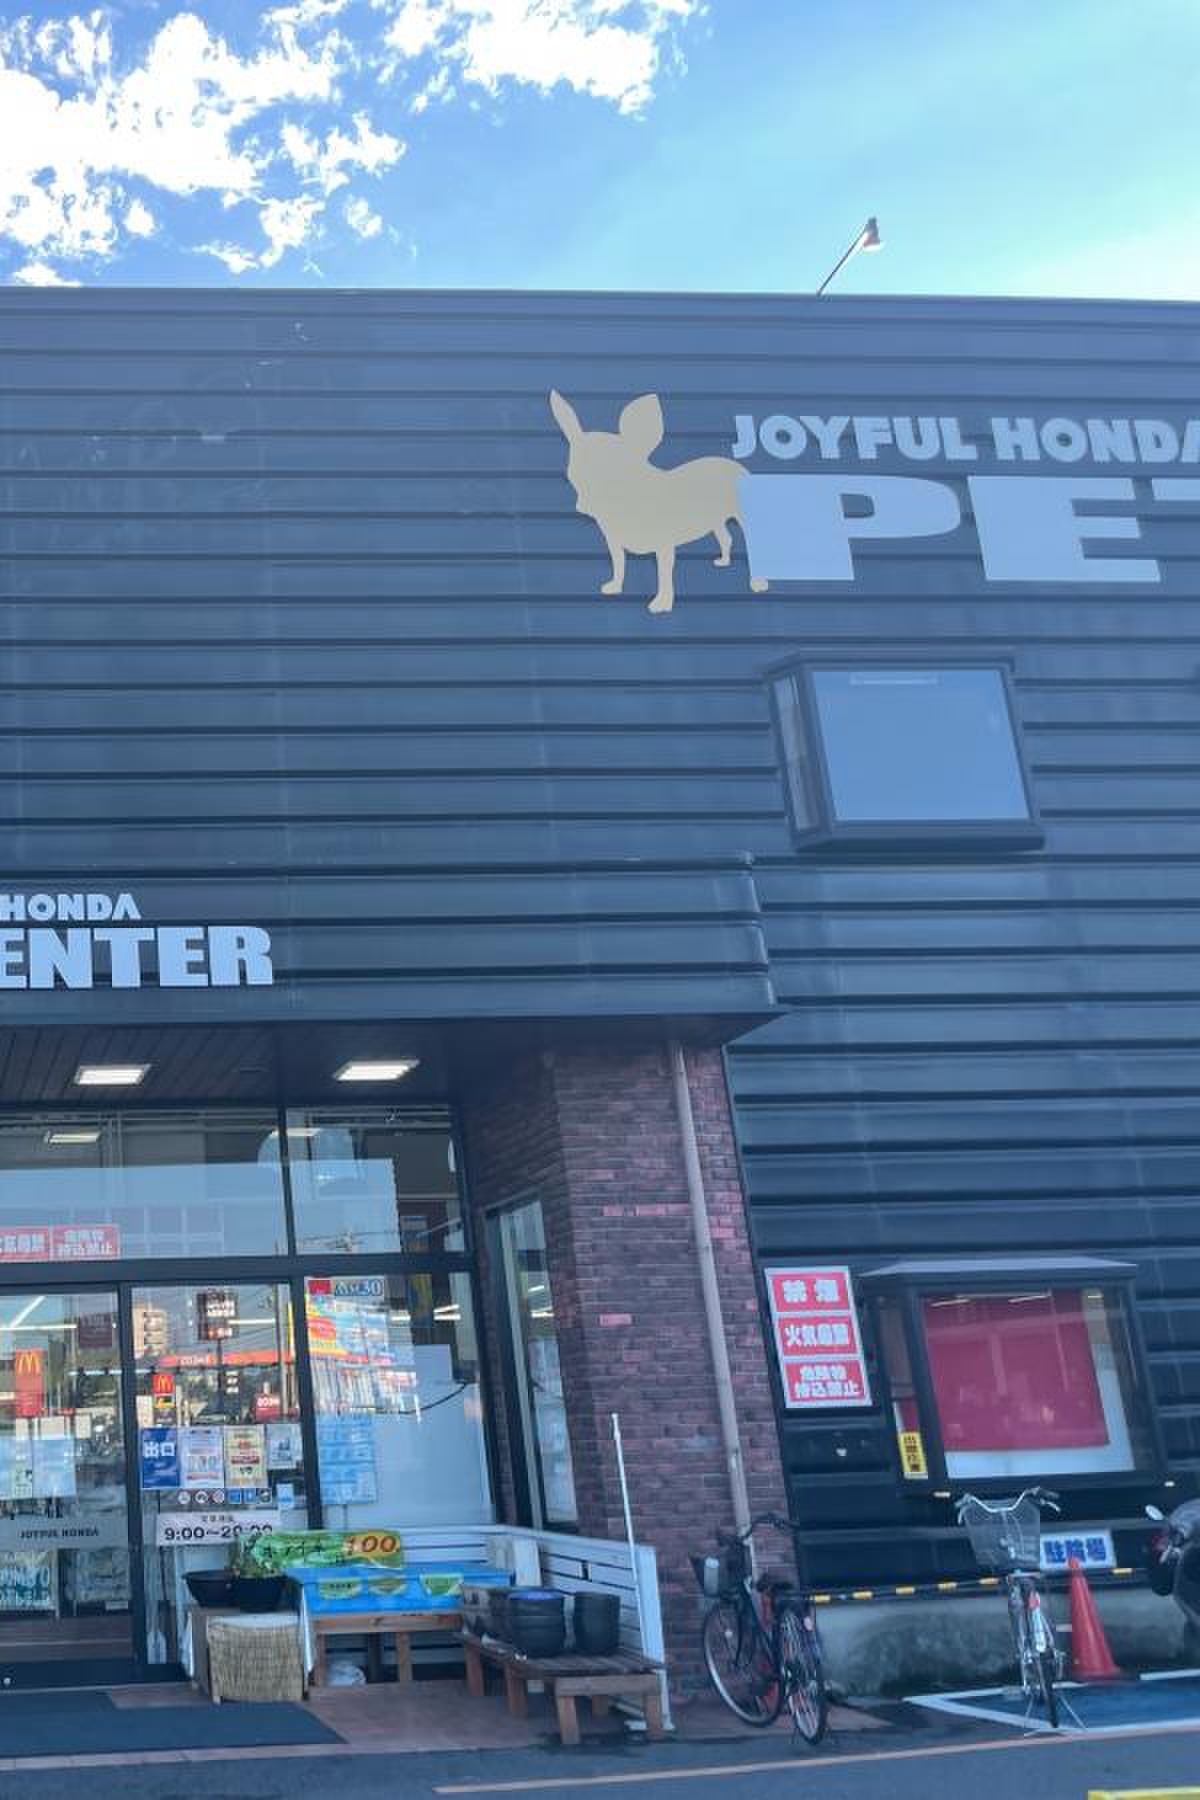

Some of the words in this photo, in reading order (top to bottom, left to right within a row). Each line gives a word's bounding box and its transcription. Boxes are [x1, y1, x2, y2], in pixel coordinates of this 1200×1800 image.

[732, 414, 978, 461] JOYFUL
[0, 894, 141, 921] HONDA
[143, 1441, 176, 1459] 出口
